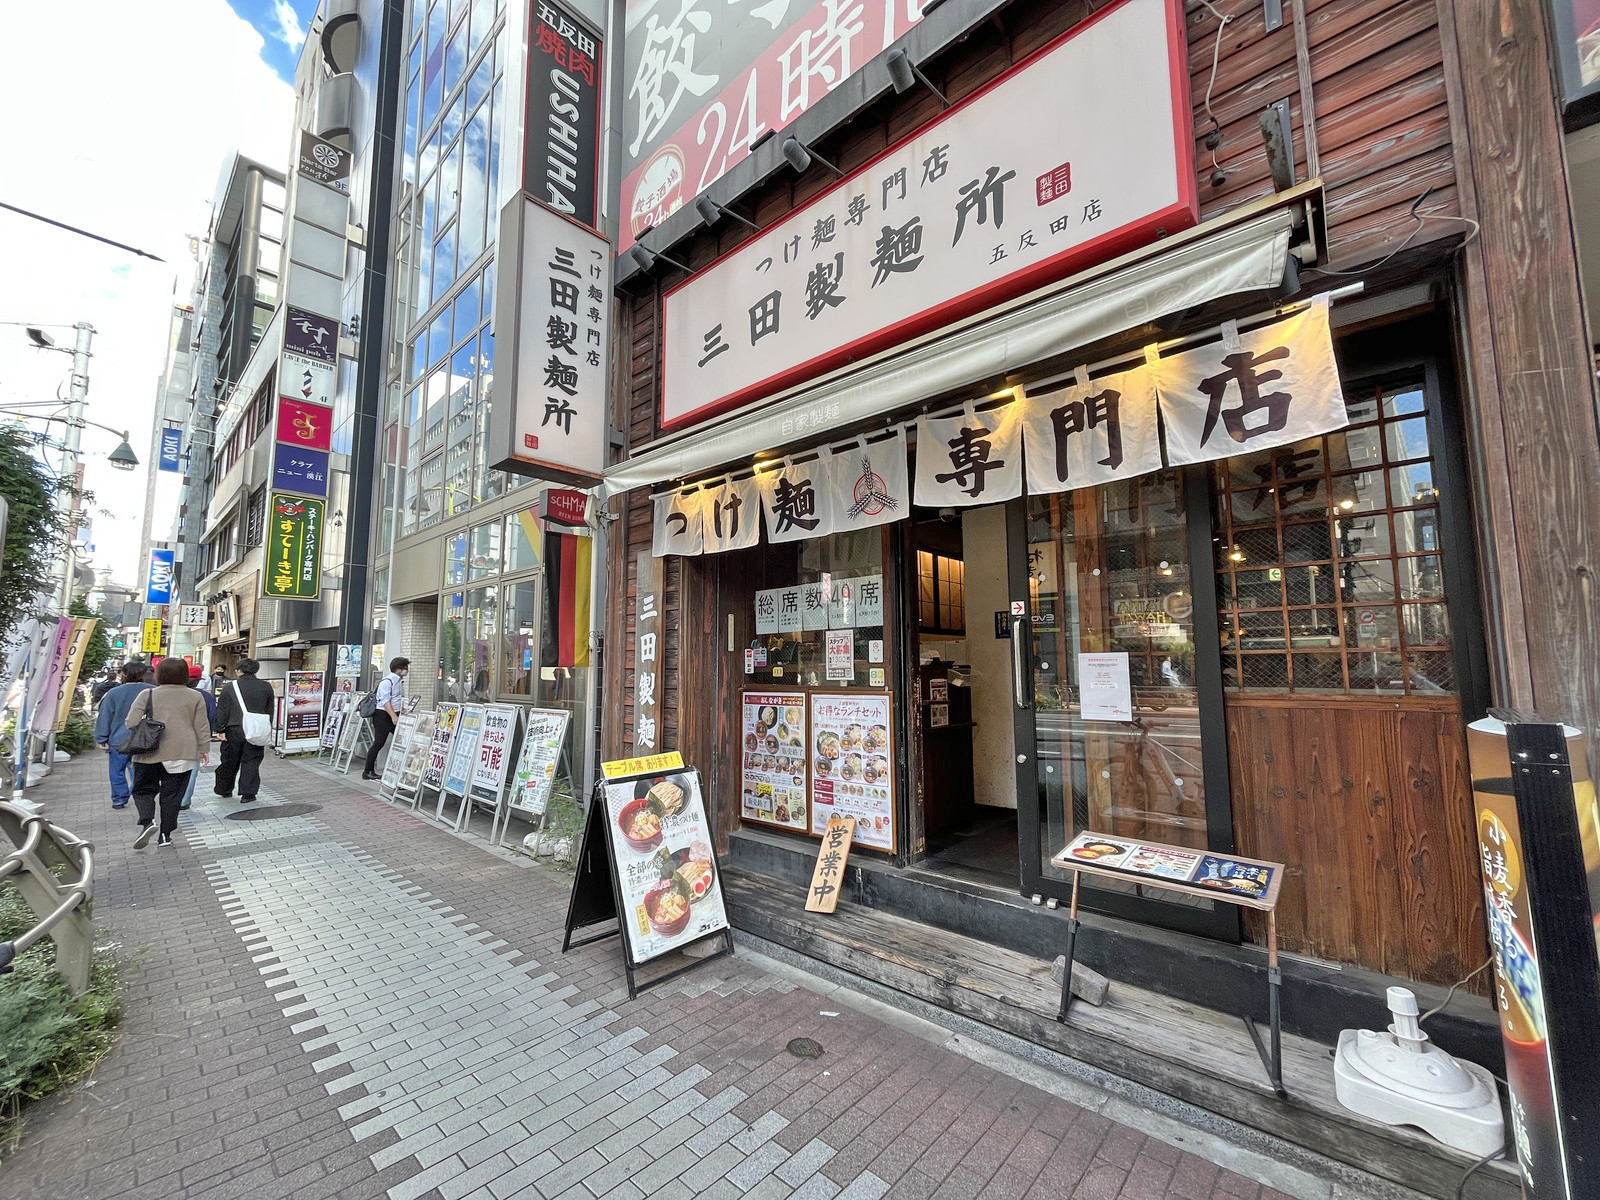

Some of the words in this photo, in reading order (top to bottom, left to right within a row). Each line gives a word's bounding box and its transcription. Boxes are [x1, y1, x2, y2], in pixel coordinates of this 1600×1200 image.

[537, 0, 595, 60] 五反田
[535, 20, 594, 87] 焼肉
[335, 180, 347, 191] 9F
[755, 144, 950, 275] つけ麺専門店
[989, 199, 1104, 266] 五反田店
[697, 166, 1017, 369] 三田製麺所
[586, 249, 603, 367] つけ麺専門店
[541, 247, 582, 435] 三田製麺所
[782, 401, 840, 436] 自家製麺
[162, 435, 179, 462] AOKI
[290, 459, 314, 469] クラブ
[665, 478, 820, 549] つけ麺
[935, 346, 1293, 498] 専門店
[277, 468, 303, 476] ニュー
[273, 519, 296, 593] すてーき亭
[150, 559, 171, 593] AOKI
[486, 715, 509, 728] 飲食物の
[818, 705, 882, 718] お得なランチセット
[483, 730, 506, 744] 持ち込み
[480, 744, 503, 770] 可能
[606, 760, 644, 776] テーブル席
[813, 825, 849, 906] 営業中
